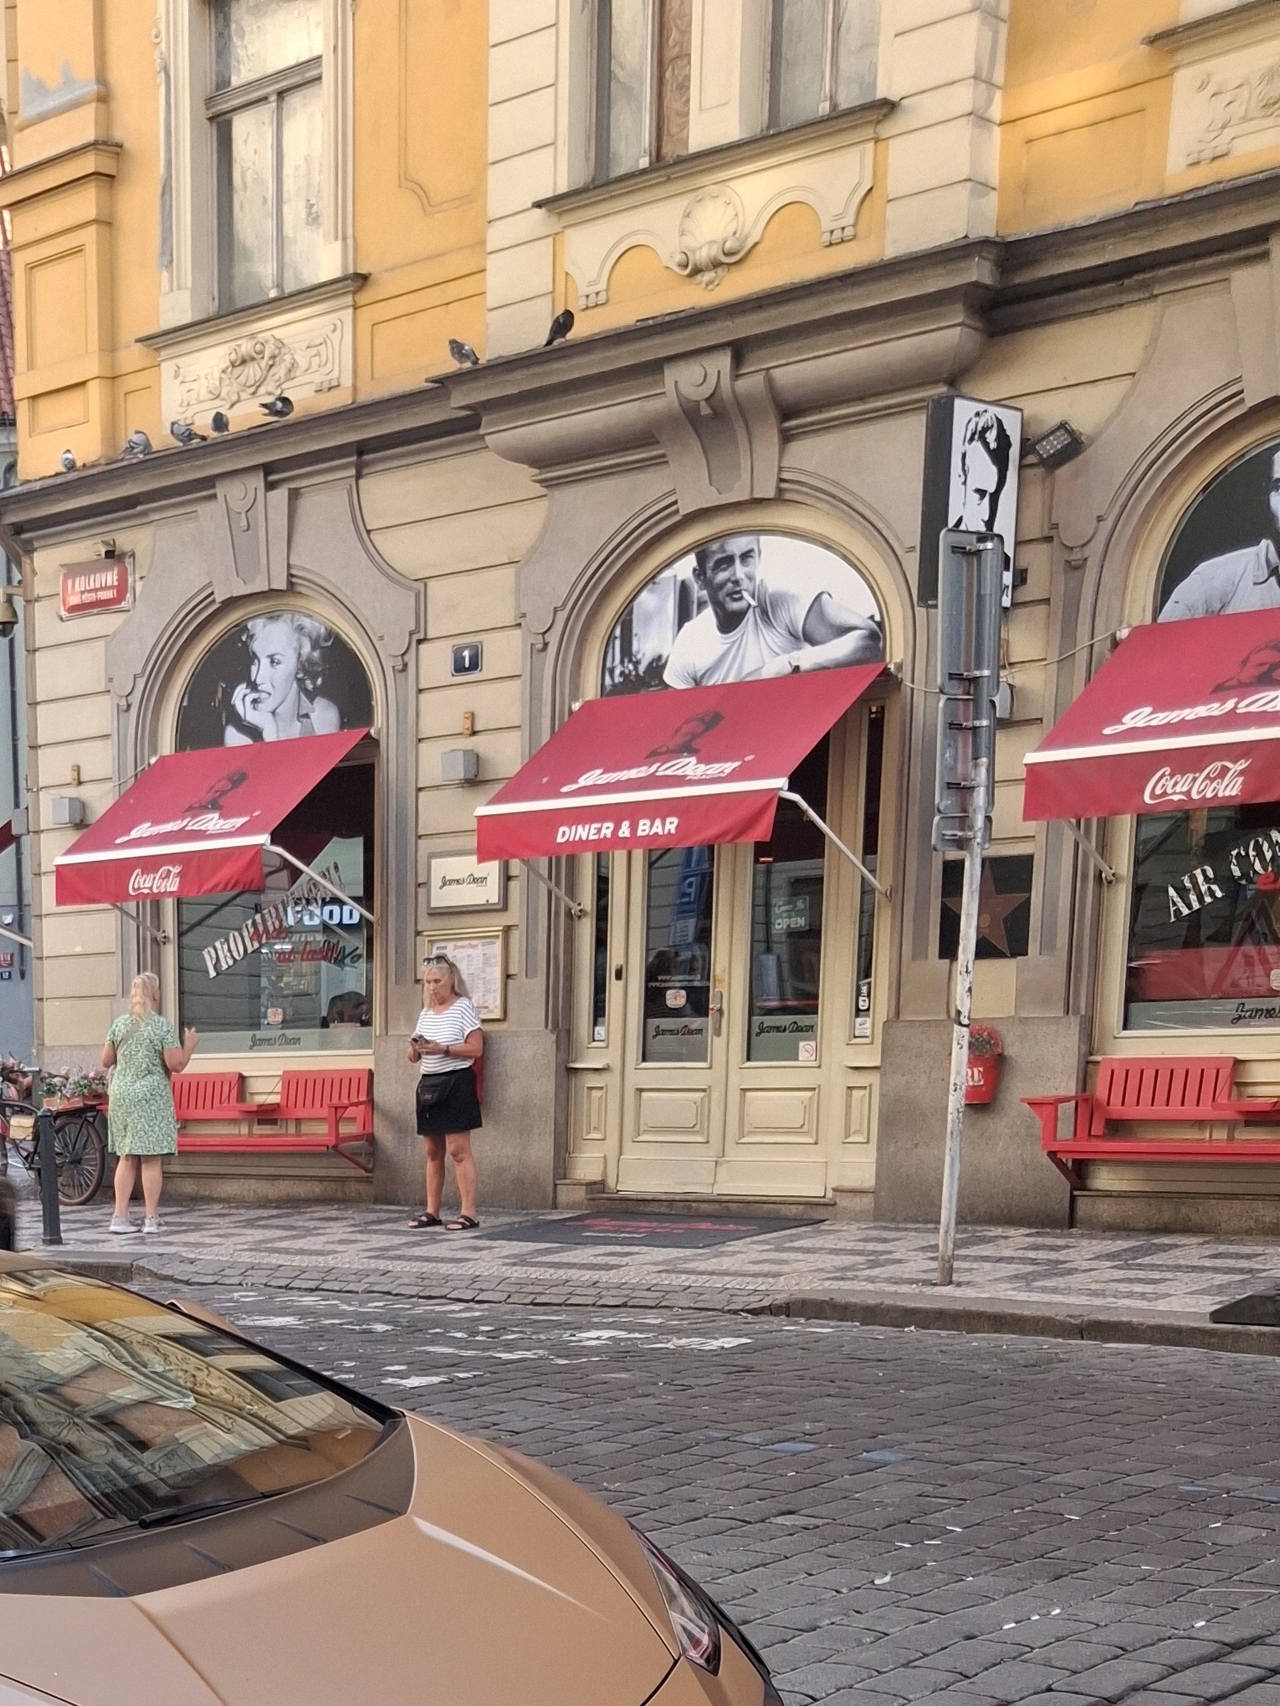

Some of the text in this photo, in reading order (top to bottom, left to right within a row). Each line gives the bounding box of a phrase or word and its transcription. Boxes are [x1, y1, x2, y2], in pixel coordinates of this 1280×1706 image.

[462, 649, 470, 669] 1
[1102, 697, 1238, 735] James
[560, 757, 742, 793] James Dean
[1144, 758, 1253, 804] Coca-Cola
[115, 812, 251, 844] James Dean
[556, 817, 679, 843] DINER & BAR
[128, 864, 183, 896] Coca-Cola
[439, 873, 488, 890] James Dean
[1168, 865, 1225, 923] AIR
[287, 905, 361, 926] FOOD
[775, 917, 806, 930] OPEN
[1231, 1003, 1280, 1025] Jame
[652, 1024, 680, 1039] James
[755, 1021, 814, 1037] James Dean
[249, 1033, 277, 1050] James
[965, 1067, 984, 1087] RE
